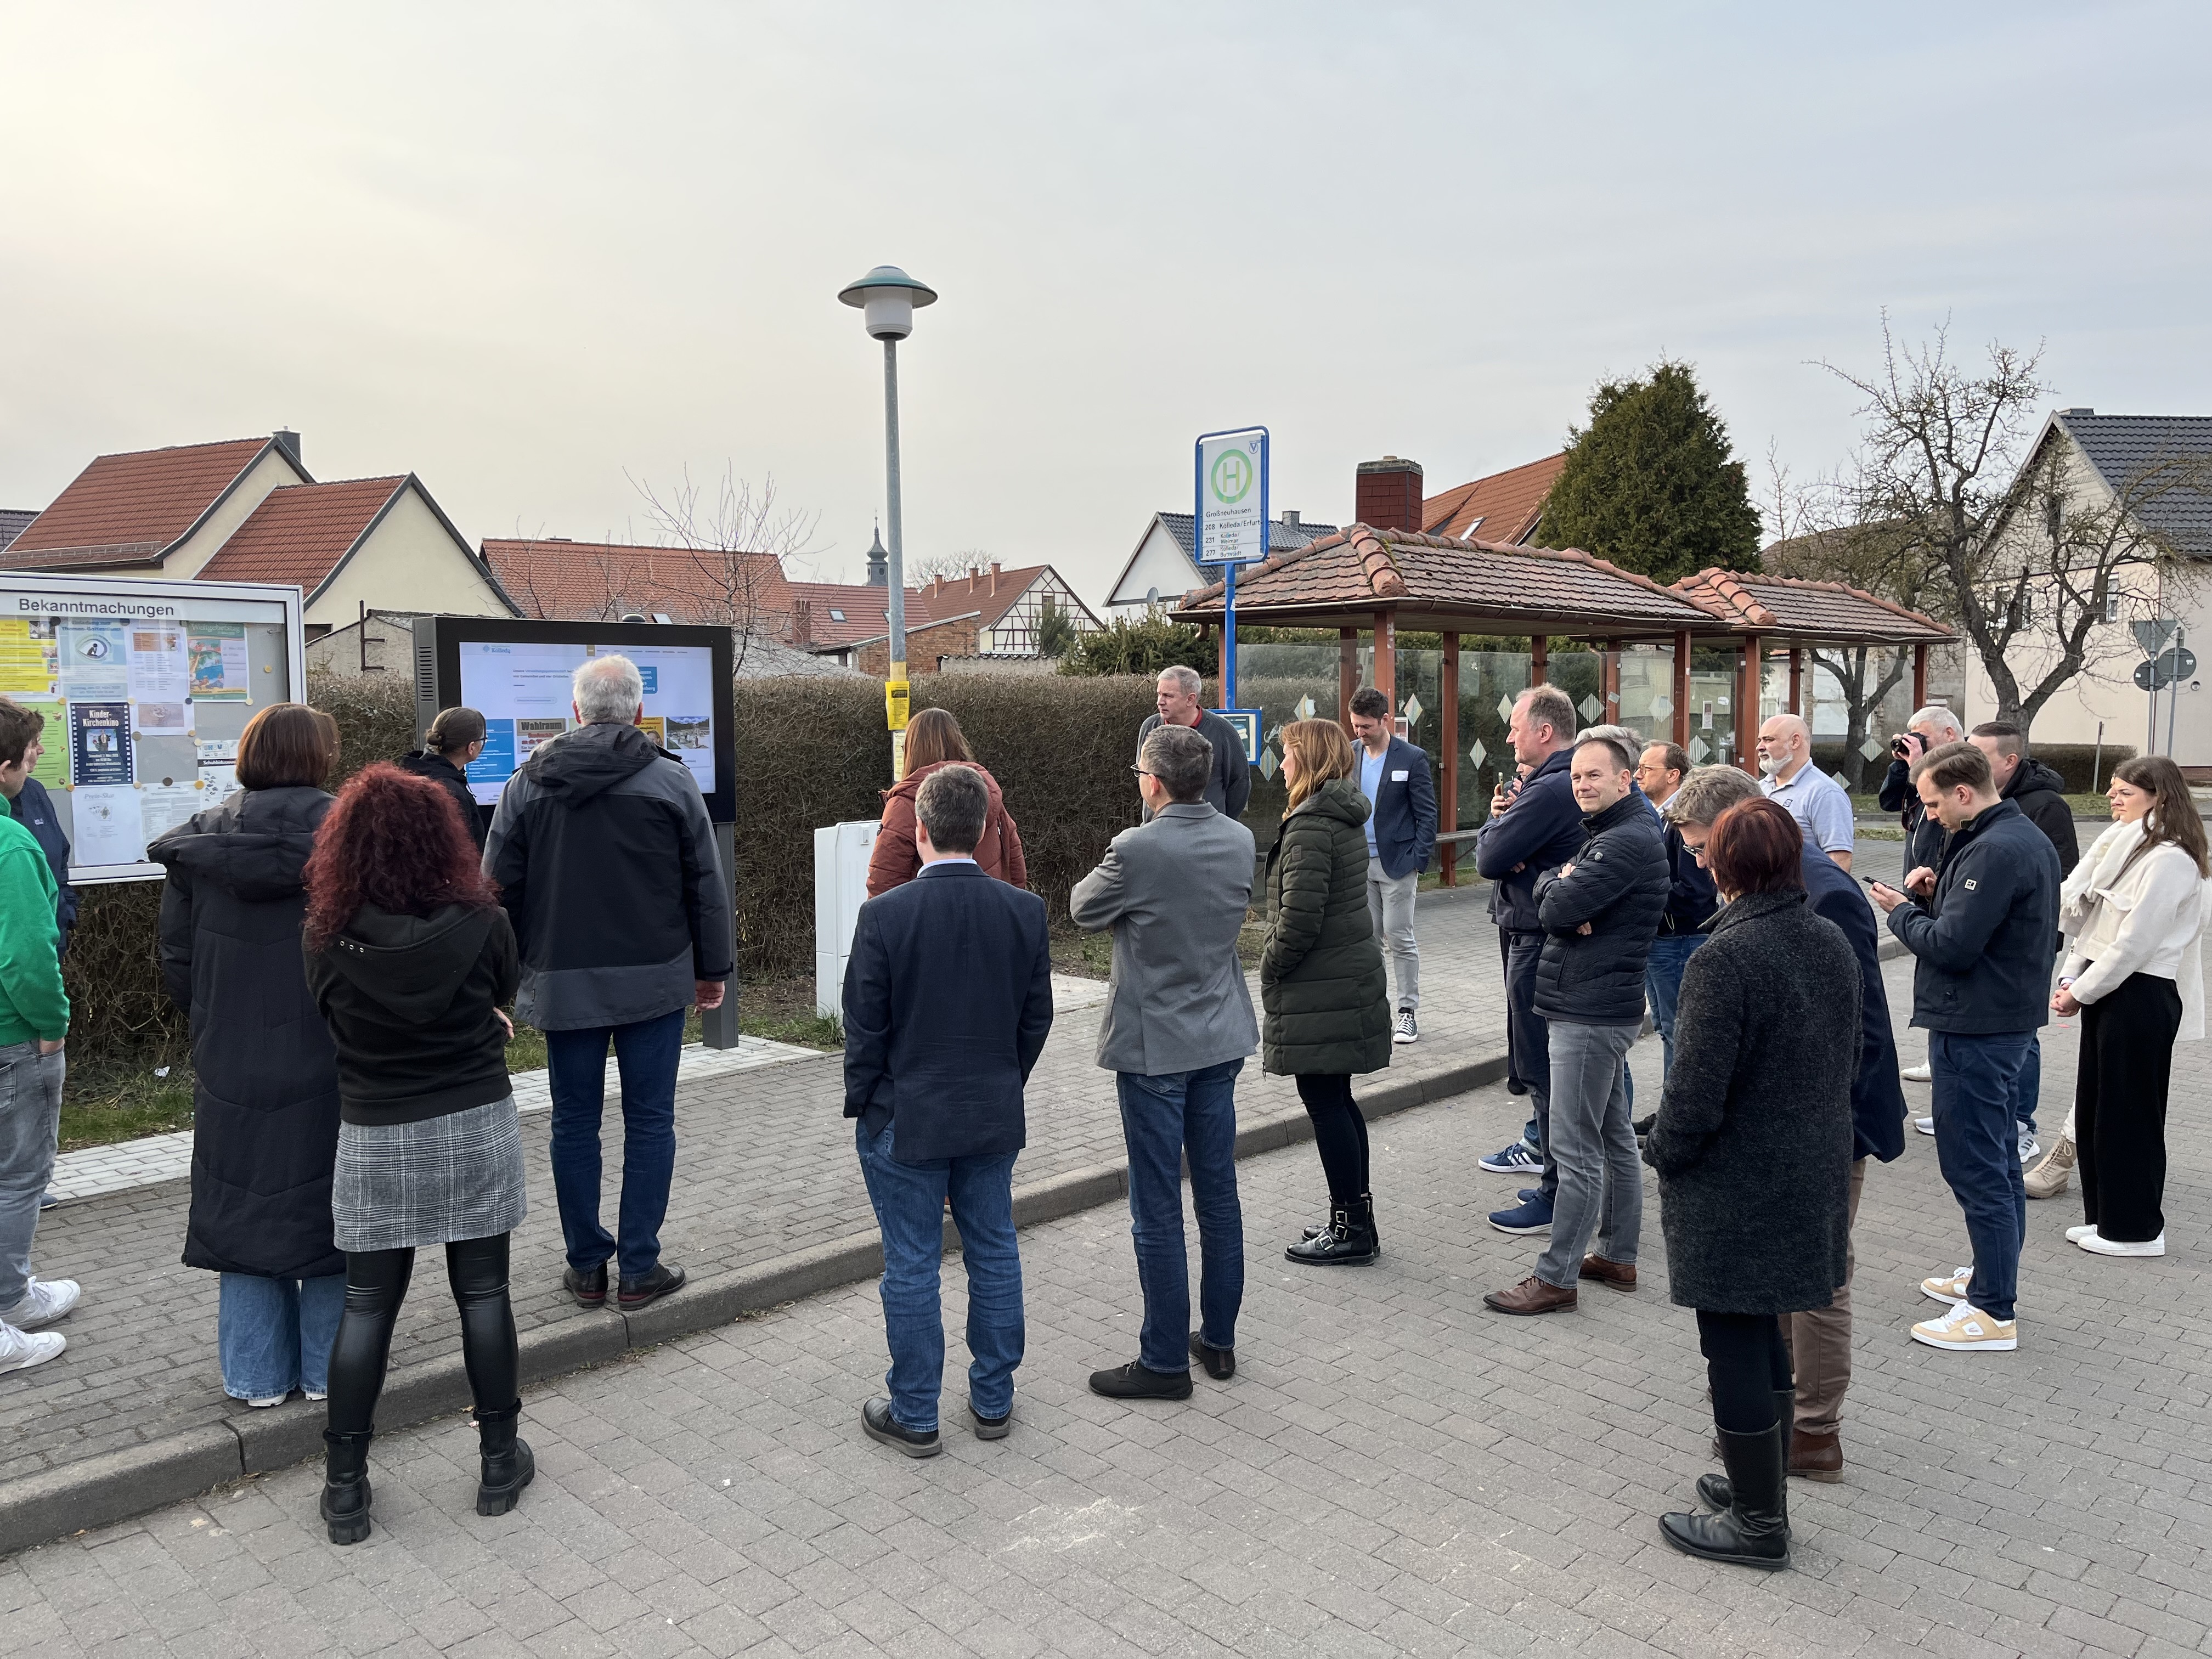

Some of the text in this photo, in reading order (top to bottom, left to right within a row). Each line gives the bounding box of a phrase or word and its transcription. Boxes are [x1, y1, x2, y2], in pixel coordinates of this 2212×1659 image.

[1223, 460, 1240, 493] H
[1206, 508, 1251, 518] Großneuhausen
[1220, 520, 1260, 529] Kölleda/Erfurt
[19, 599, 174, 618] Bekanntmachungen
[89, 710, 112, 718] Kinder-
[82, 718, 119, 727] Kirchenkino
[521, 721, 562, 730] Wahlraum
